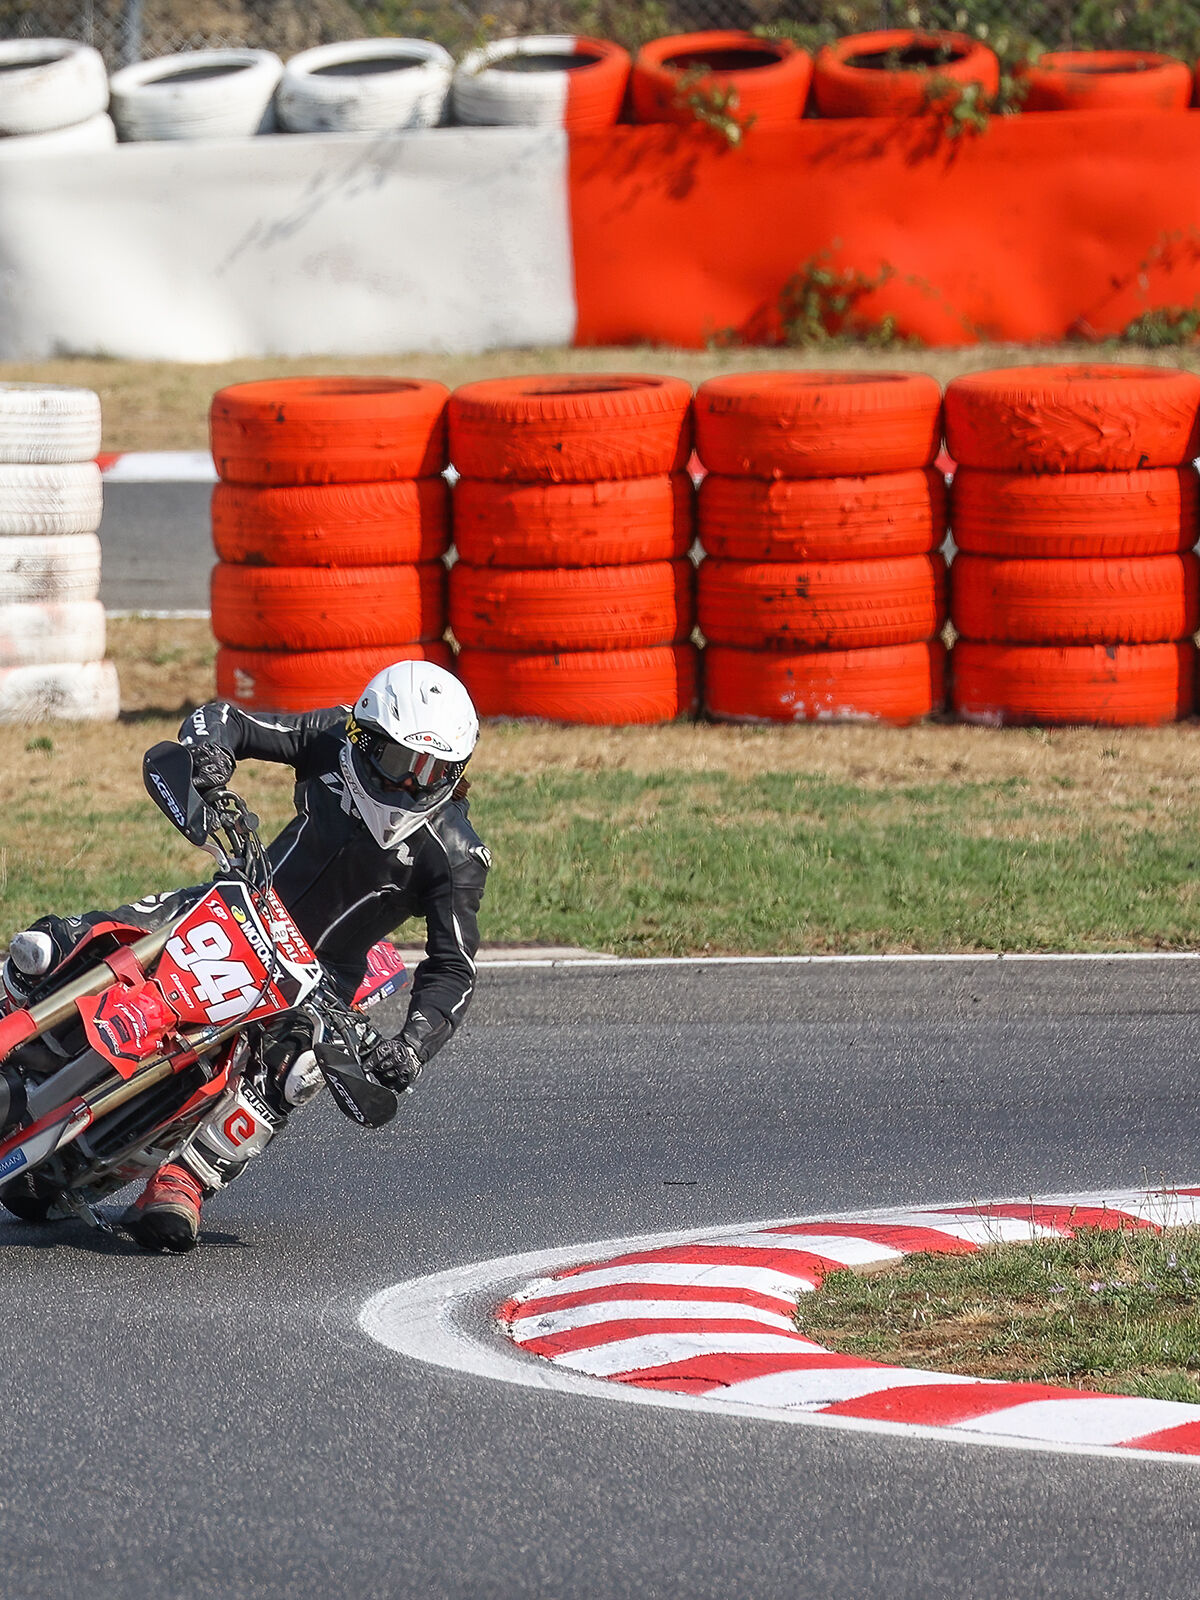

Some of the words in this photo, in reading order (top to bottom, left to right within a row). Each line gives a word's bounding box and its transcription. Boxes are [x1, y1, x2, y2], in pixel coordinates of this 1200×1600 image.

[191, 705, 210, 736] XON
[149, 772, 186, 827] ACERBIS
[165, 920, 268, 1024] 941
[239, 920, 285, 985] MOTOREX
